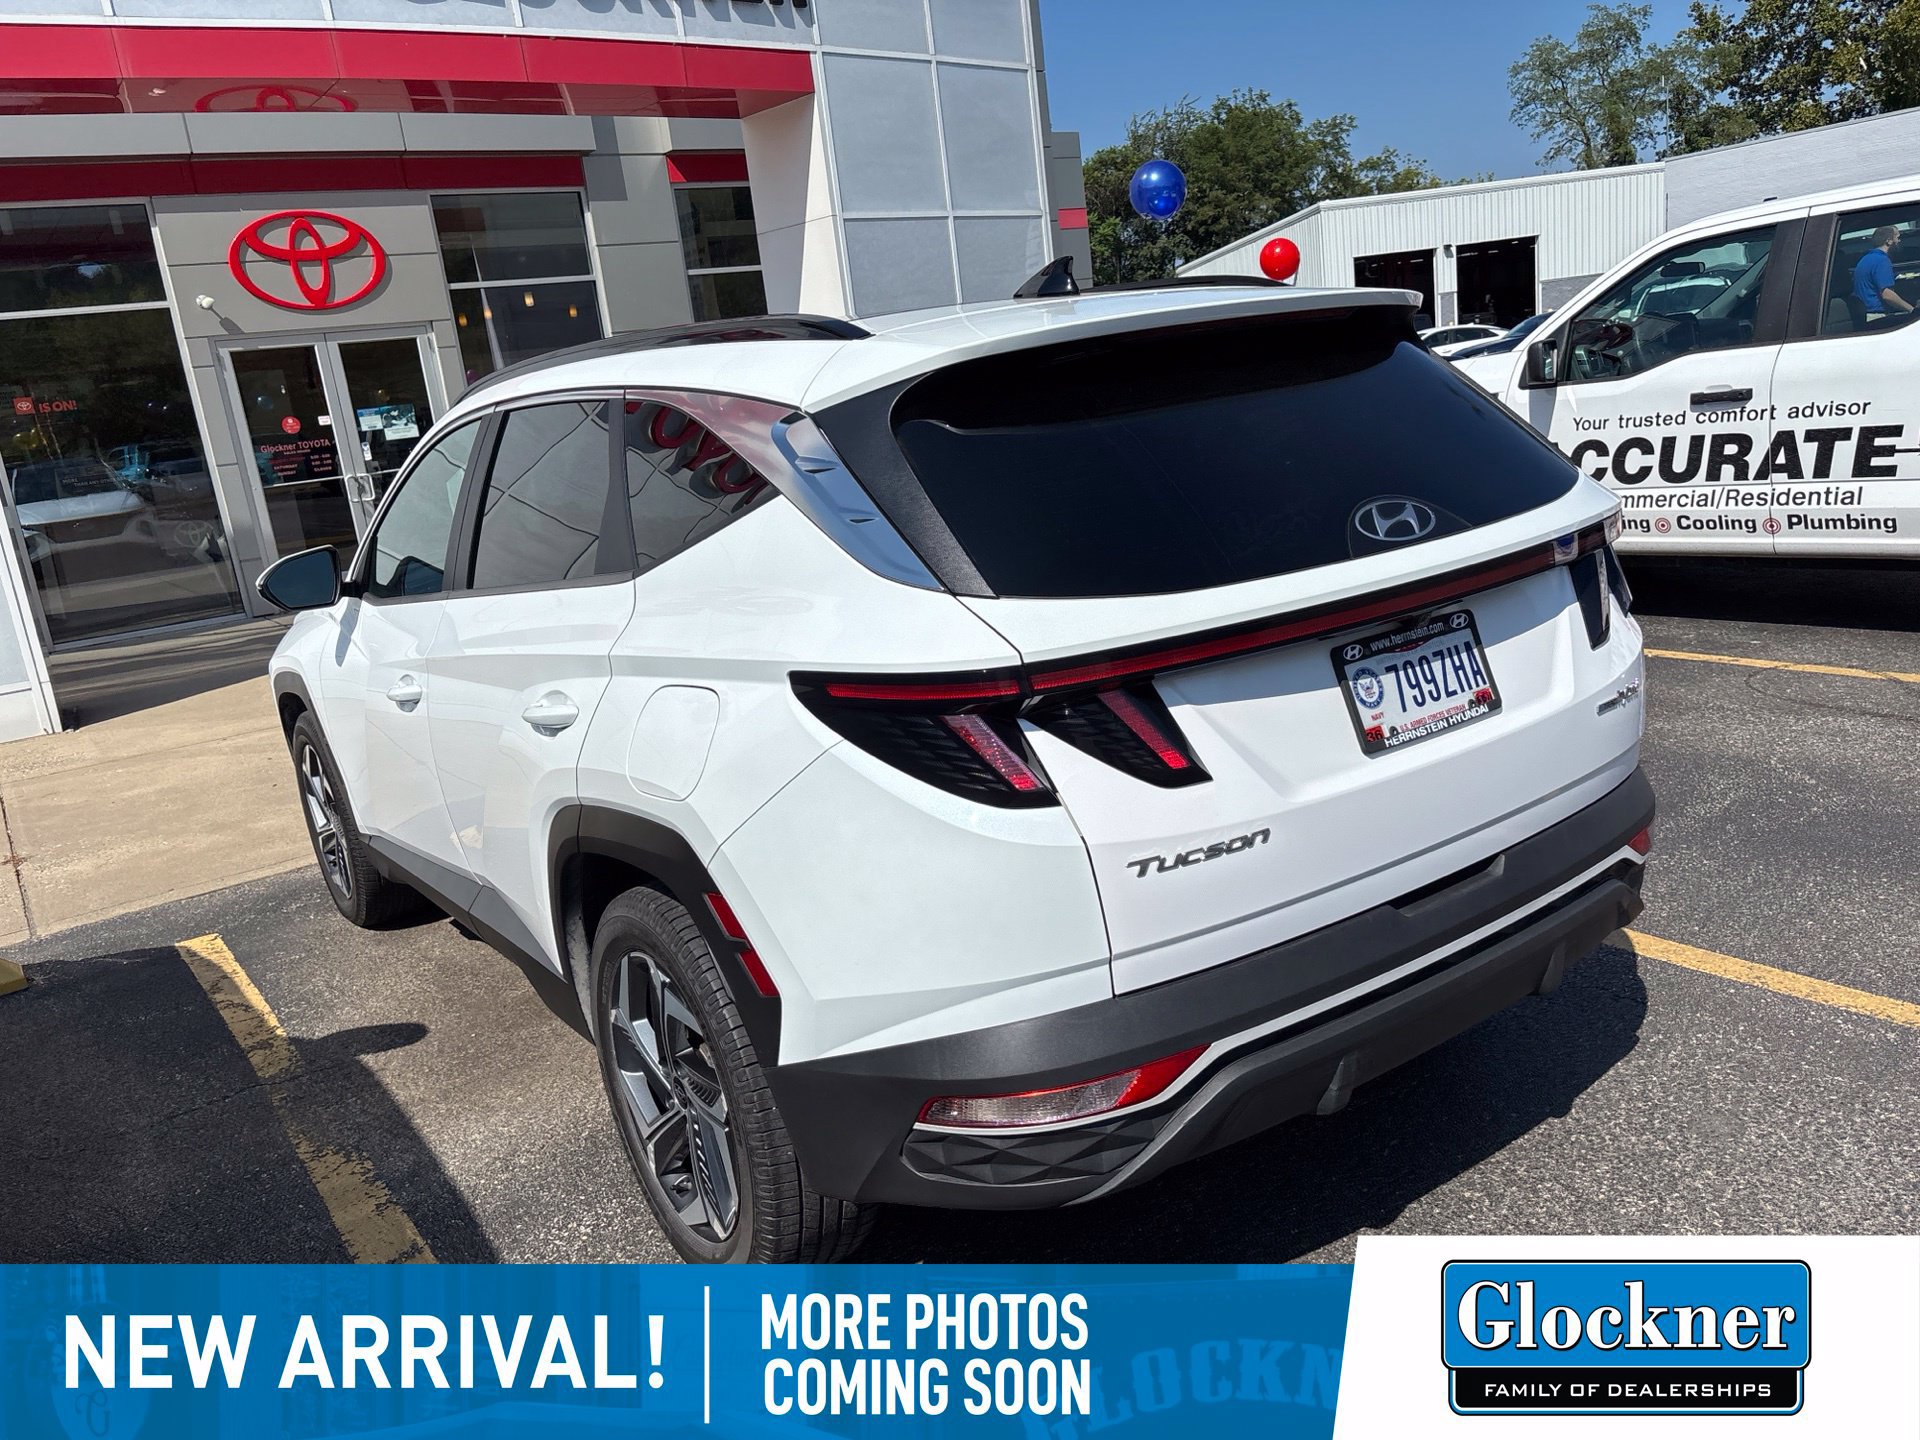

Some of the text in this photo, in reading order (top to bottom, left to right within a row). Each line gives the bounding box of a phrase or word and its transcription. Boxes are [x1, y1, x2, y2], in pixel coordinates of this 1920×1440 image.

[38, 400, 78, 413] IS ON!
[1572, 400, 1872, 432] Your trusted comfort advisor
[260, 438, 331, 453] Glockner TOYOTA
[1553, 423, 1905, 486] CCURATE
[1620, 486, 1864, 509] mmercial/Residential
[1676, 514, 1757, 534] Cooling
[1787, 513, 1898, 534] Plumbing
[1369, 622, 1445, 652] www.herrnstein.com
[1385, 640, 1488, 713] 799ZHA
[1371, 712, 1385, 722] NAVY
[1384, 704, 1489, 748] HERRNSTEIN HYUNDAI
[1410, 717, 1428, 730] ARMED
[1427, 711, 1446, 723] FORCES
[1445, 703, 1466, 716] VETERAN
[1366, 729, 1385, 744] 36
[1125, 827, 1271, 878] TUCSON
